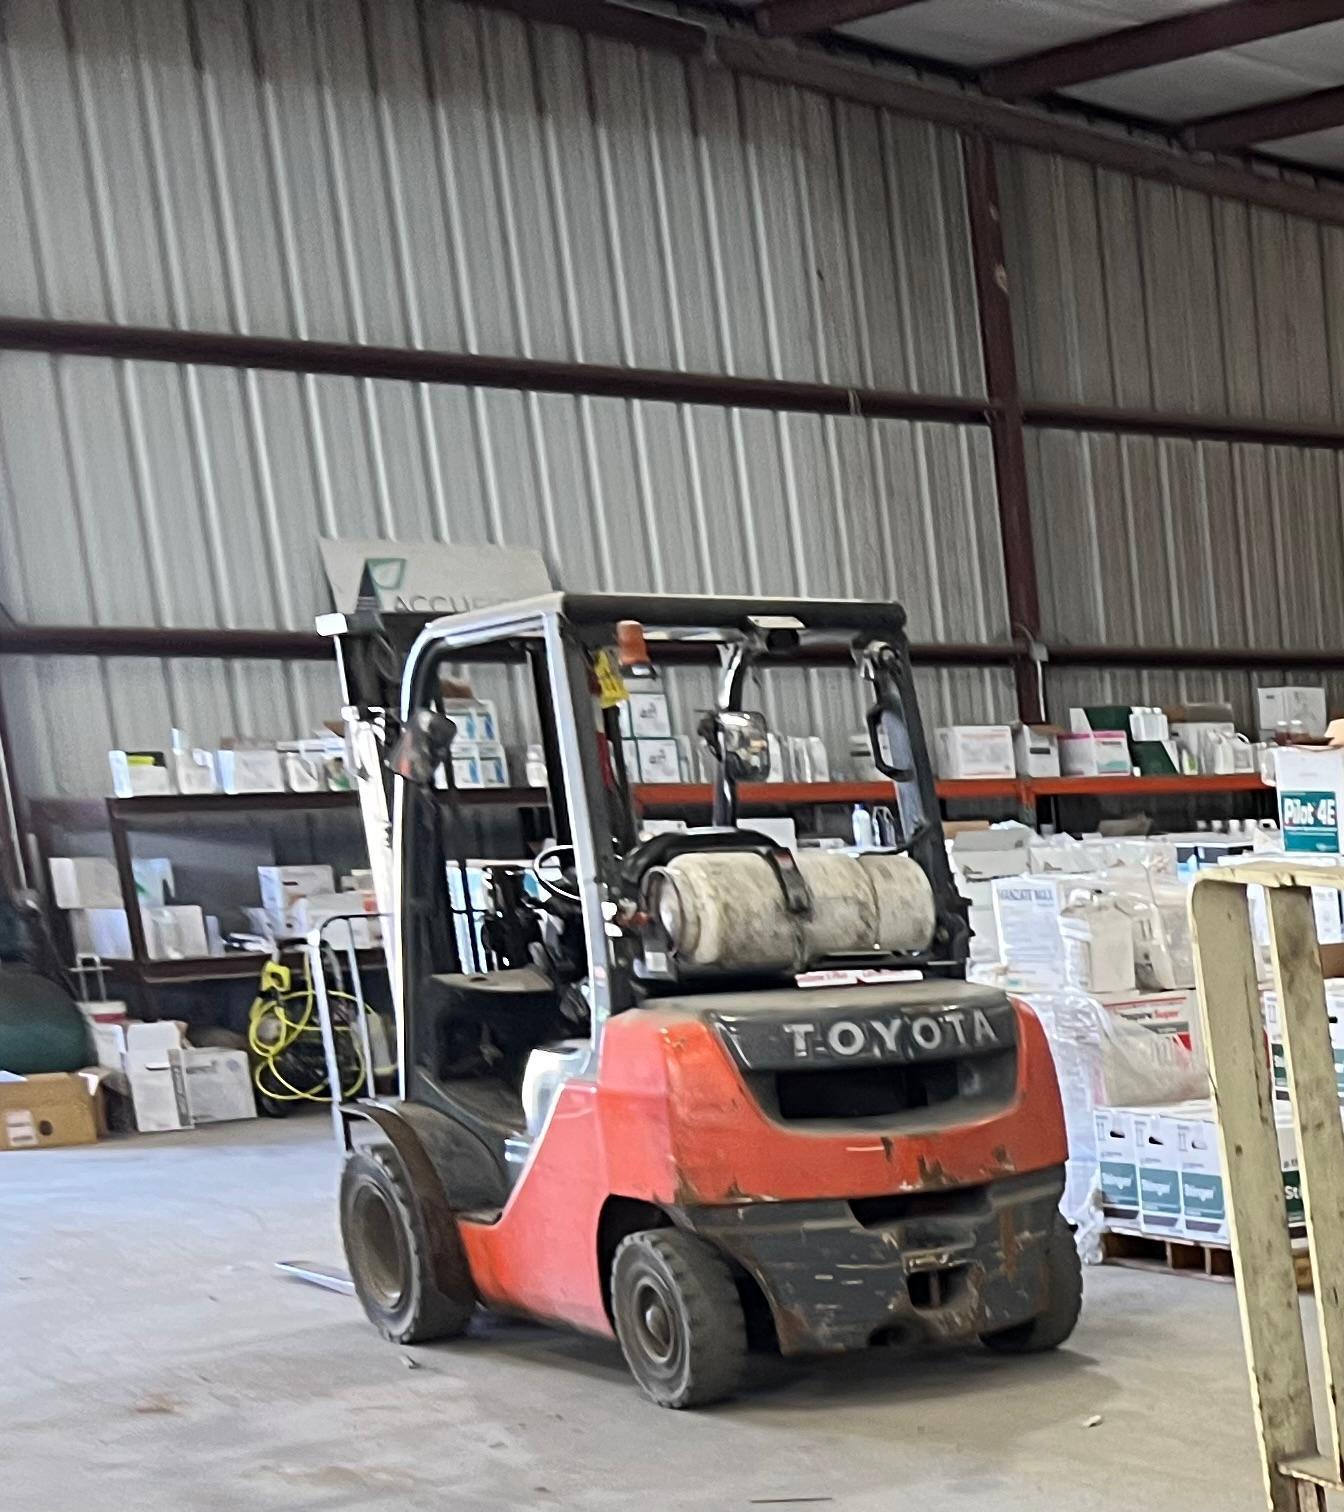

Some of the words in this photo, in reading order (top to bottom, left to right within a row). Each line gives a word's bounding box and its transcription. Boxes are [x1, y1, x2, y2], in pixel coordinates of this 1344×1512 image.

[1283, 798, 1315, 825] Pilot
[1317, 798, 1336, 825] 4E
[783, 1009, 999, 1057] TOYOTA
